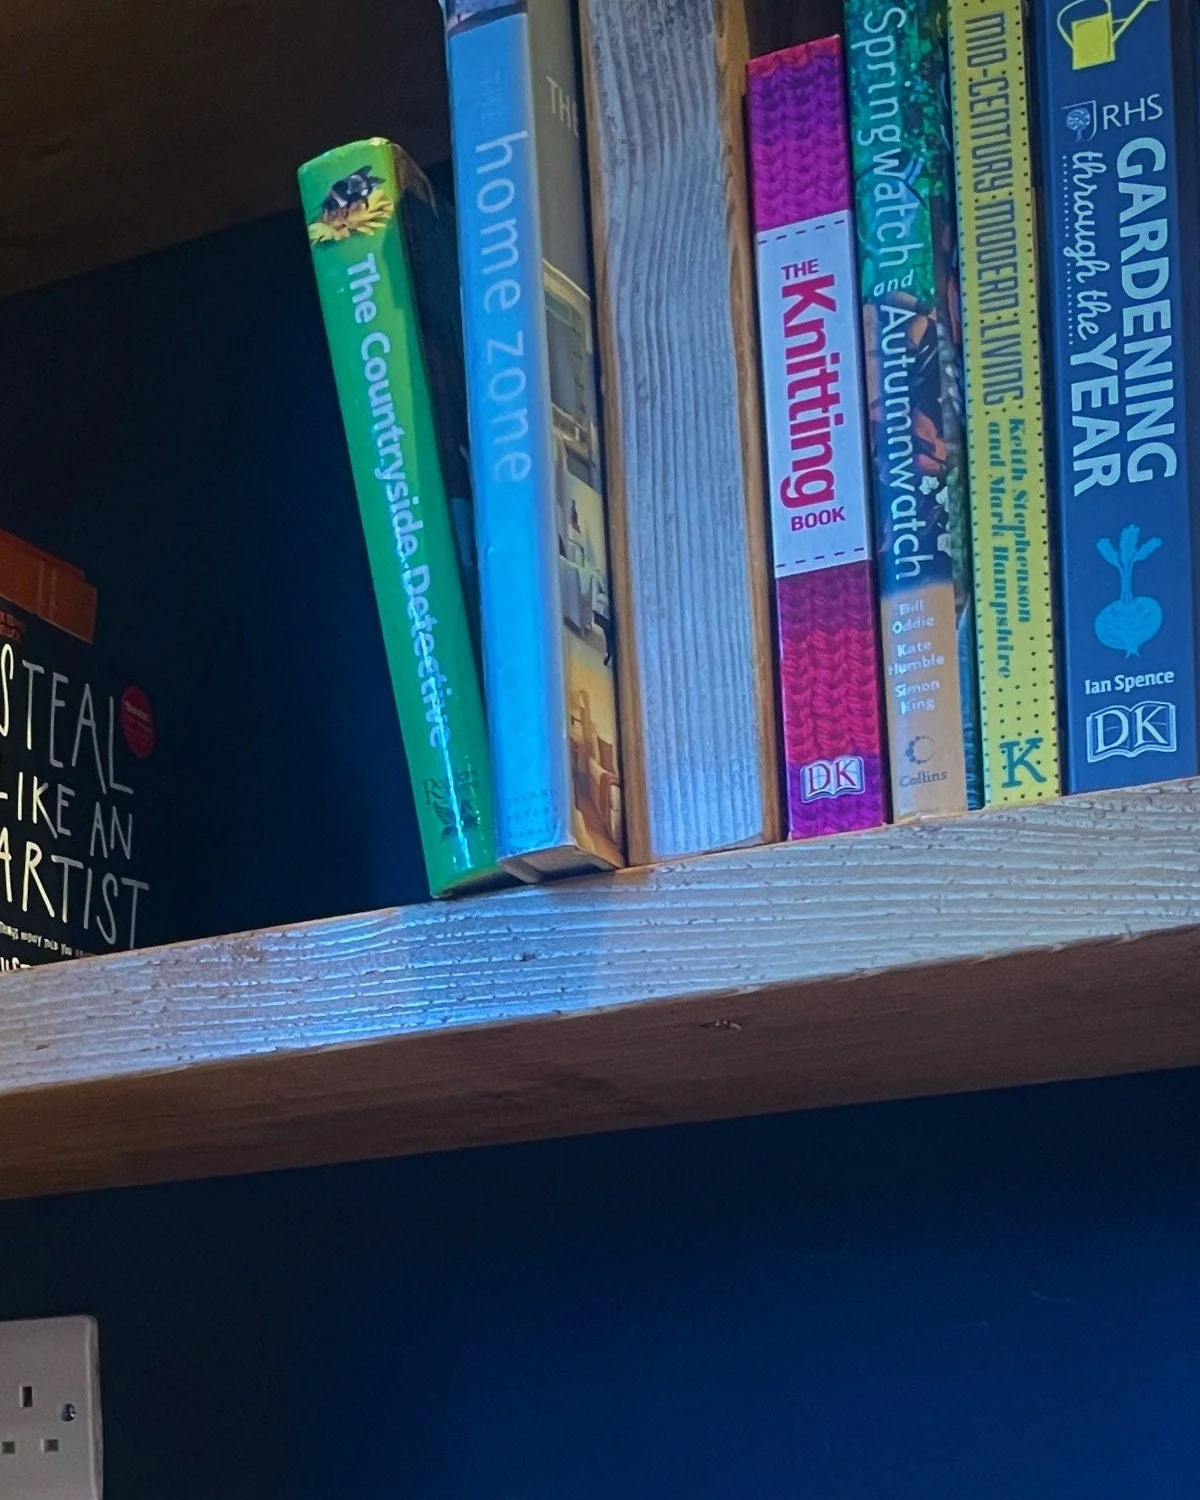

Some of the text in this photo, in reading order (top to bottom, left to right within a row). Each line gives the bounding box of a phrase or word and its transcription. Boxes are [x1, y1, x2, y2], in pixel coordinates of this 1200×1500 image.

[1103, 93, 1164, 130] RHS
[781, 258, 820, 281] THE
[1063, 151, 1112, 340] through the
[347, 252, 381, 324] The
[475, 130, 533, 482] home zone
[851, 7, 934, 582] Springwatch and Autumnwatch
[1116, 137, 1178, 483] GARDENING
[980, 319, 1025, 407] LIVING
[780, 274, 843, 510] Knitting
[1070, 333, 1121, 497] YEAR
[361, 331, 425, 557] Countryside
[791, 506, 846, 532] BOOK
[893, 616, 935, 634] Oddie
[899, 599, 924, 615] Bill
[402, 563, 451, 748] Detective
[888, 654, 946, 677] Humble
[897, 640, 932, 657] Kate
[895, 680, 941, 698] Simon
[1085, 671, 1175, 695] Ian Spence
[1094, 705, 1170, 754] DK
[900, 769, 948, 788] Collins
[1000, 737, 1048, 788] K
[89, 801, 133, 861] AN
